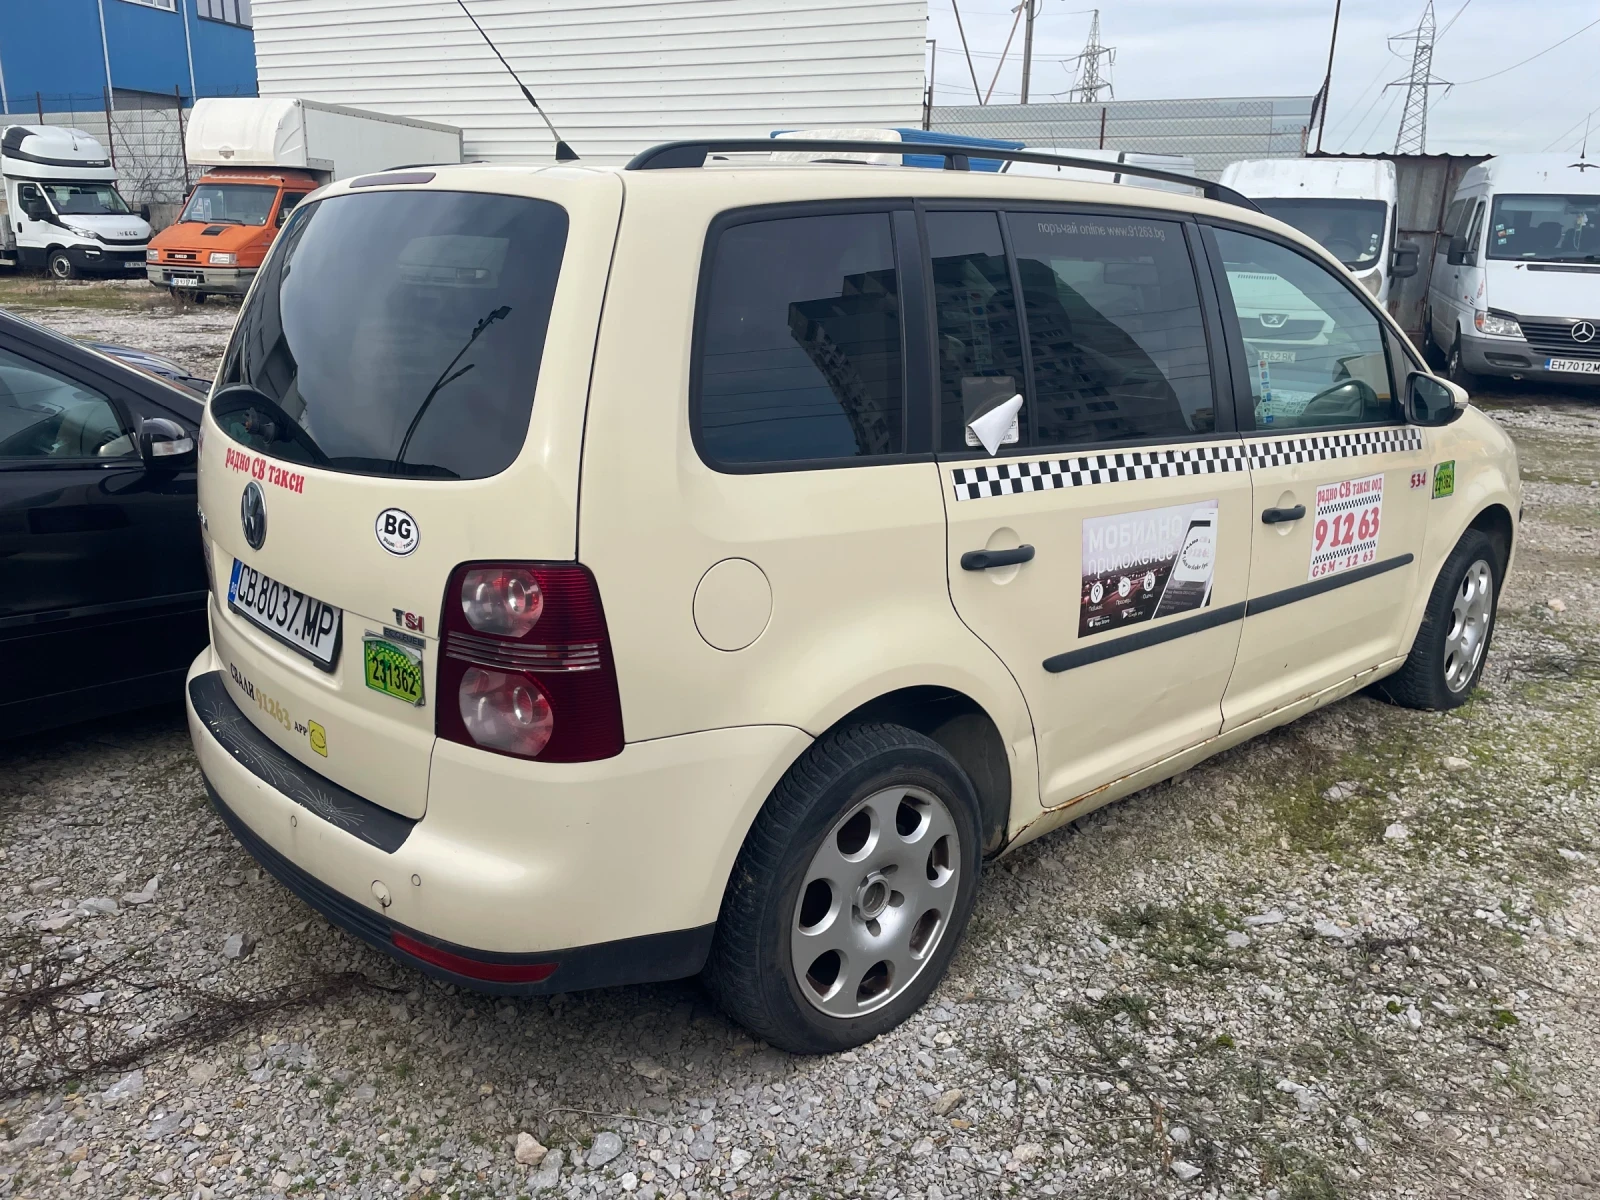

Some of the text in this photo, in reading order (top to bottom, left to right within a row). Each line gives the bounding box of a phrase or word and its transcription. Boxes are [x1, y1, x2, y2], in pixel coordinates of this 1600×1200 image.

[1037, 222, 1166, 241] поръчай online www.91263.bg
[225, 447, 305, 494] радио СВ такси
[1410, 472, 1427, 489] 534
[1316, 487, 1338, 507] радио
[1339, 481, 1351, 499] СВ
[1352, 480, 1371, 495] такси
[384, 514, 411, 539] BG
[1088, 515, 1183, 553] МОБИЛНО
[1088, 544, 1174, 579] приложение
[392, 608, 424, 633] TSI
[372, 657, 417, 696] 231362
[255, 687, 292, 732] 91263
[294, 721, 308, 737] APP
